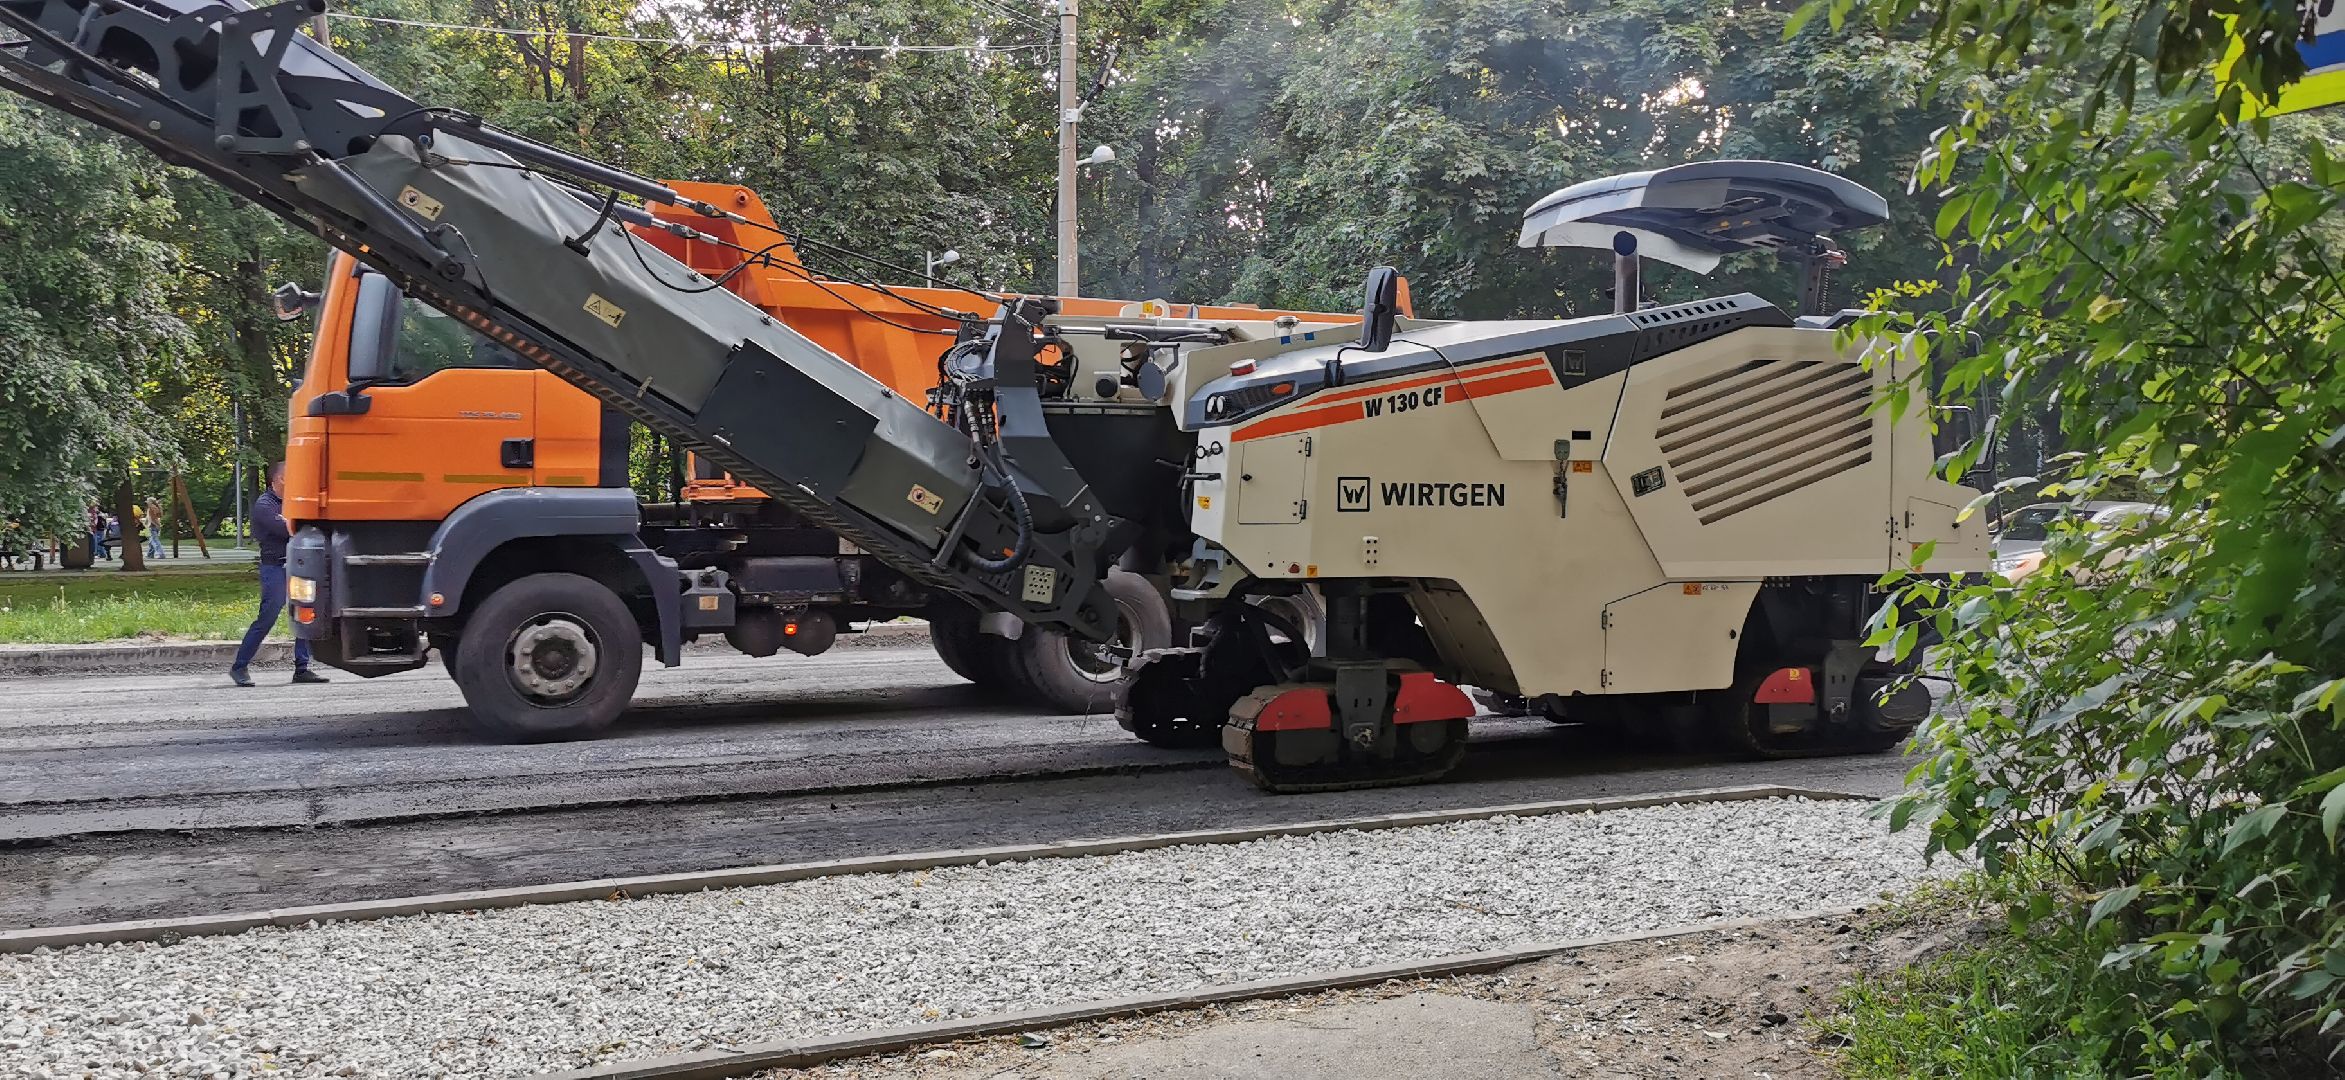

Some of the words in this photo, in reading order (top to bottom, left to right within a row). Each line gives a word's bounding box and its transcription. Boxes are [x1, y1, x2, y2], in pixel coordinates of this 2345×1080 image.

[1365, 397, 1383, 417] W
[1387, 391, 1419, 414] 130
[1423, 387, 1442, 407] CF
[1343, 485, 1366, 504] W
[1381, 482, 1505, 507] WIRTGEN
